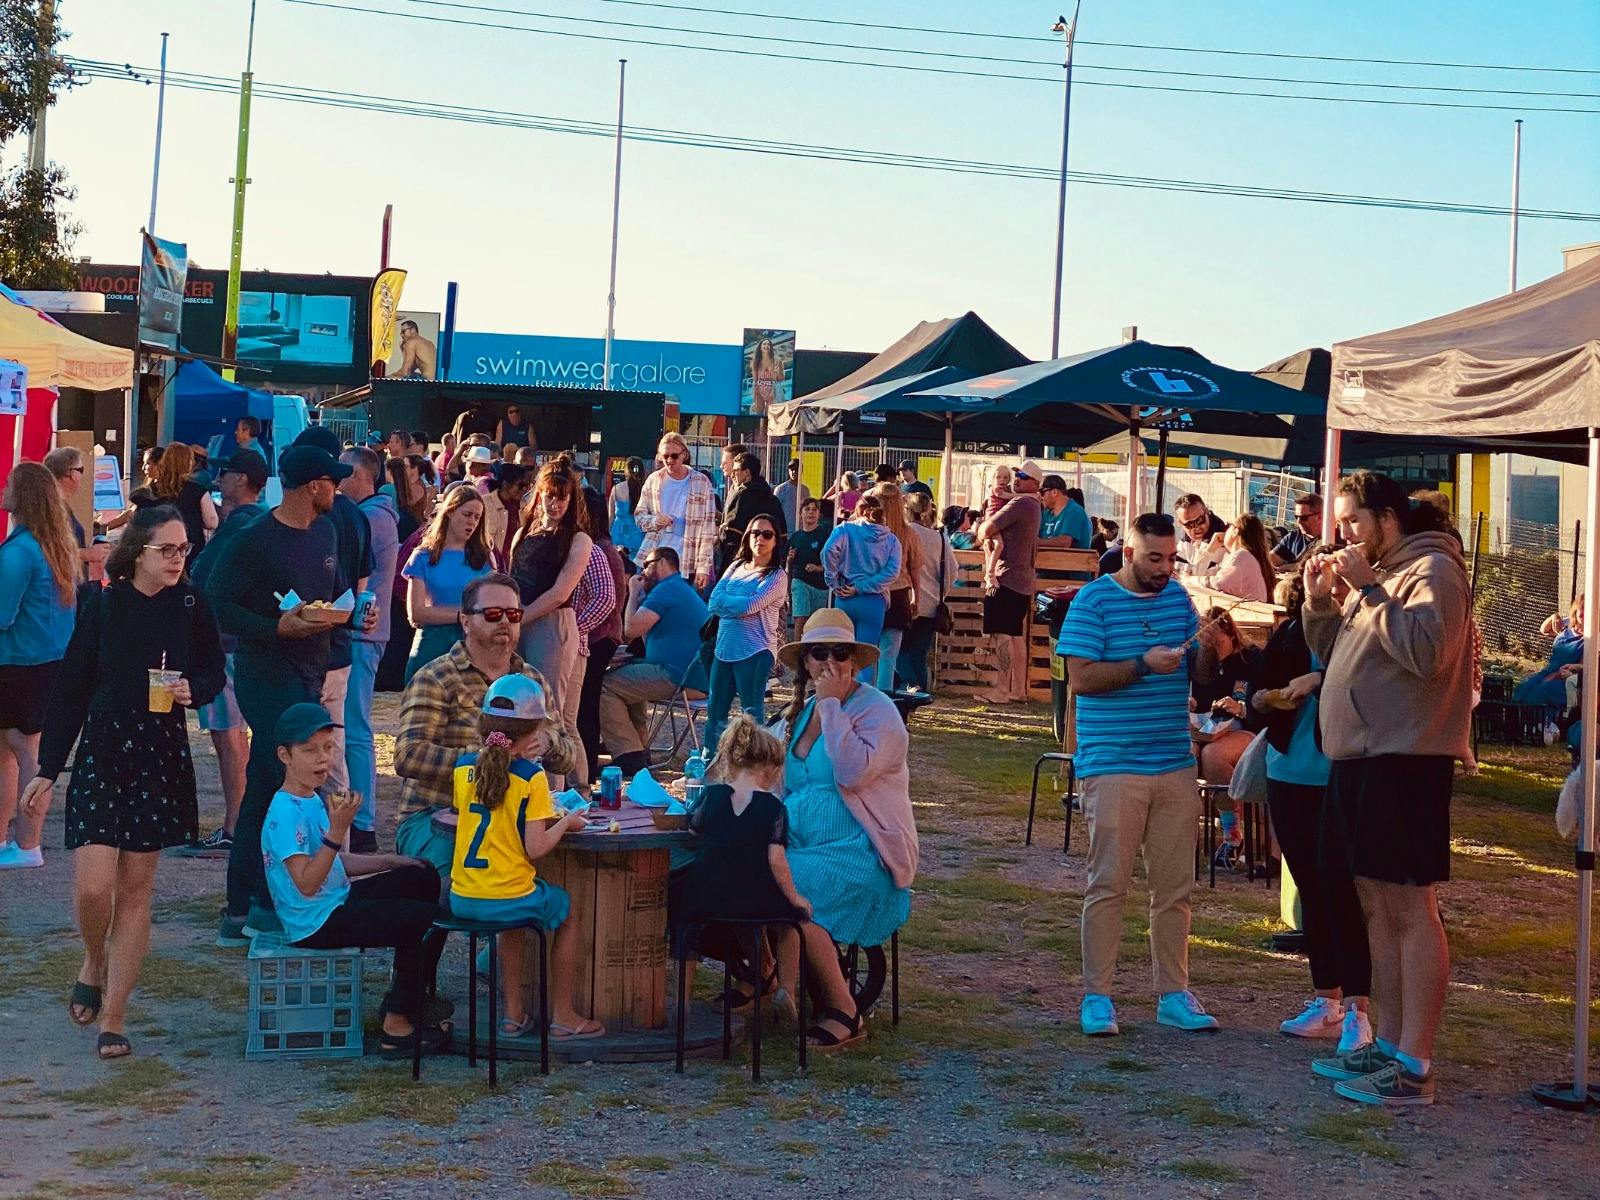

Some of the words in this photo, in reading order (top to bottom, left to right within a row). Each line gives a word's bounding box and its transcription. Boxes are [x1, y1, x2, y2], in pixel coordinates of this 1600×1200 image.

[80, 276, 214, 297] WOODKER
[105, 293, 134, 301] COOLING
[590, 382, 616, 391] BOY
[463, 802, 491, 868] 2
